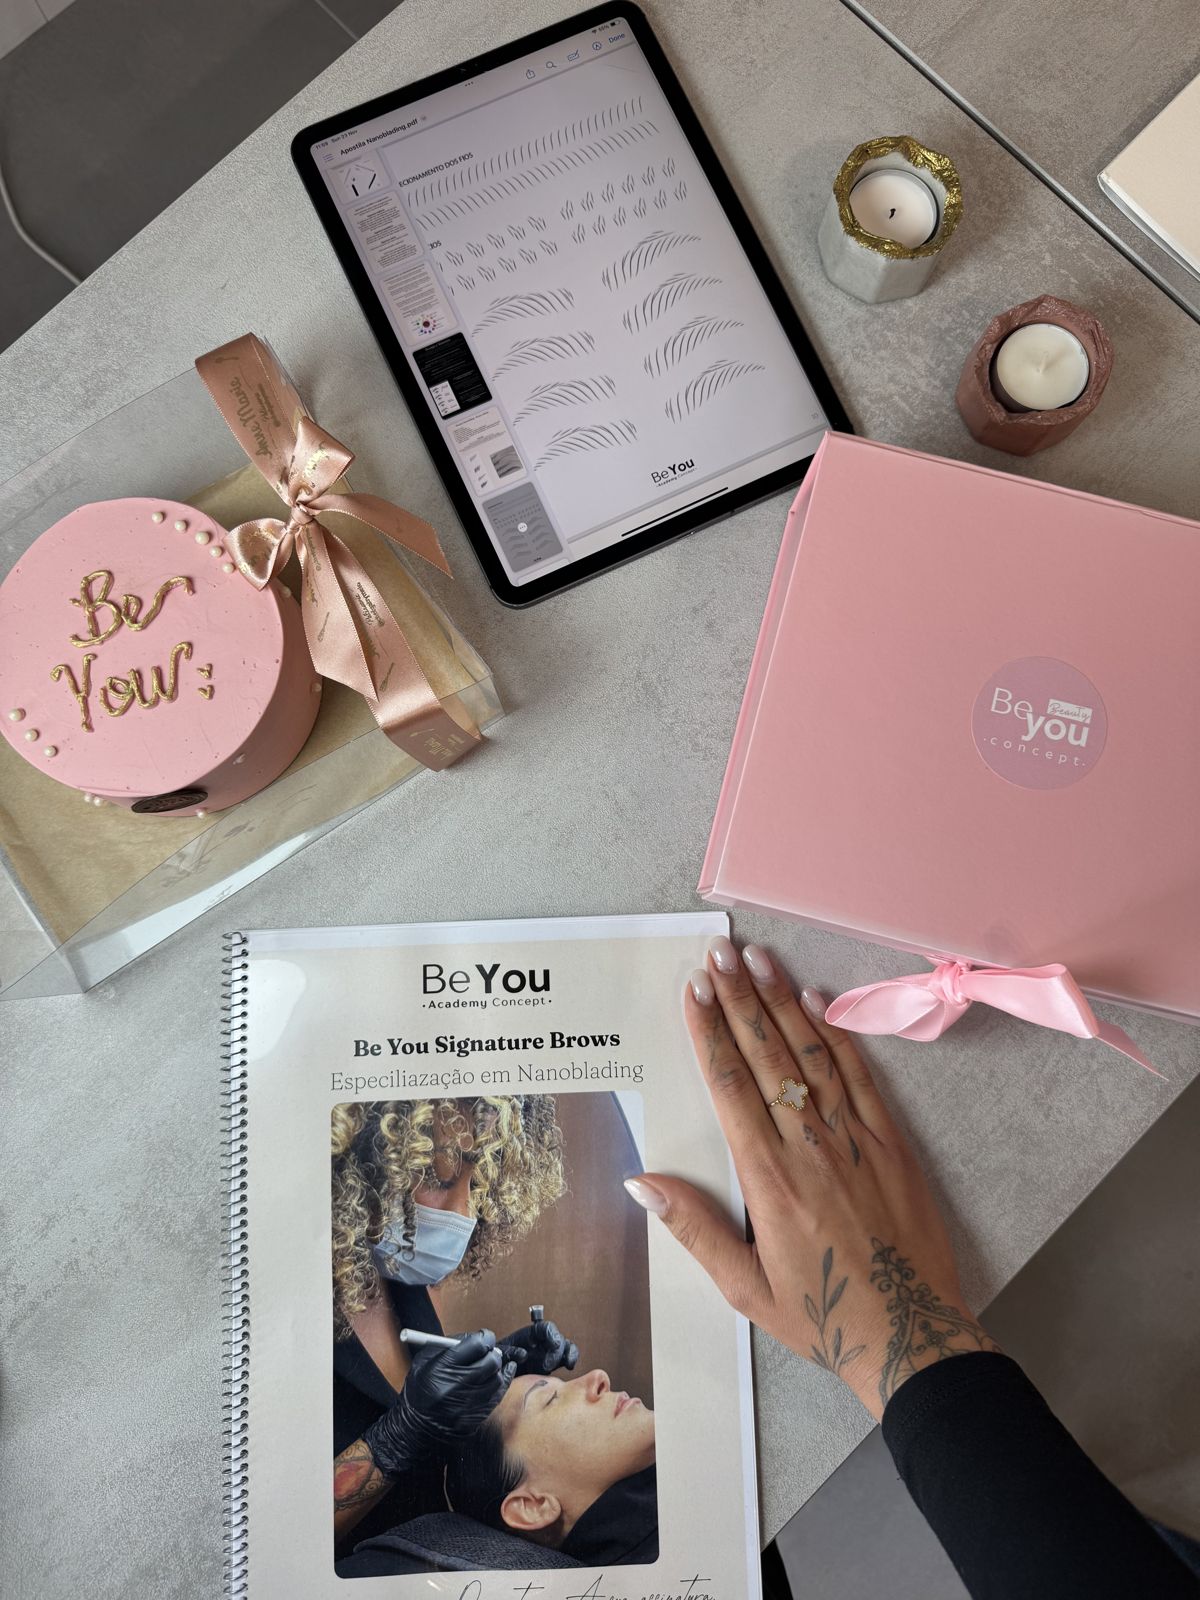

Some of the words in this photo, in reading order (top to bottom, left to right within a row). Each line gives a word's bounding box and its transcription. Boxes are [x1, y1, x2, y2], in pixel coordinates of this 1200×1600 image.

[608, 33, 626, 43] Done
[340, 140, 367, 156] Apostila
[366, 118, 418, 145] Nanoblading.pdf
[347, 129, 358, 137] Nov
[399, 164, 445, 187] ECIONAMENTO
[444, 158, 459, 169] DOS
[458, 152, 474, 163] FIOS
[69, 570, 196, 648] Be
[50, 641, 193, 733] You
[991, 687, 1033, 720] Be
[1021, 712, 1090, 748] you
[428, 998, 488, 1010] Academy
[492, 996, 547, 1008] Concept
[353, 1038, 382, 1057] Be
[386, 1037, 430, 1056] You
[434, 1034, 545, 1058] Signature
[549, 1031, 621, 1050] Brows
[330, 1067, 475, 1095] Especiliazação
[480, 1070, 511, 1084] em
[517, 1060, 644, 1083] Nanoblading
